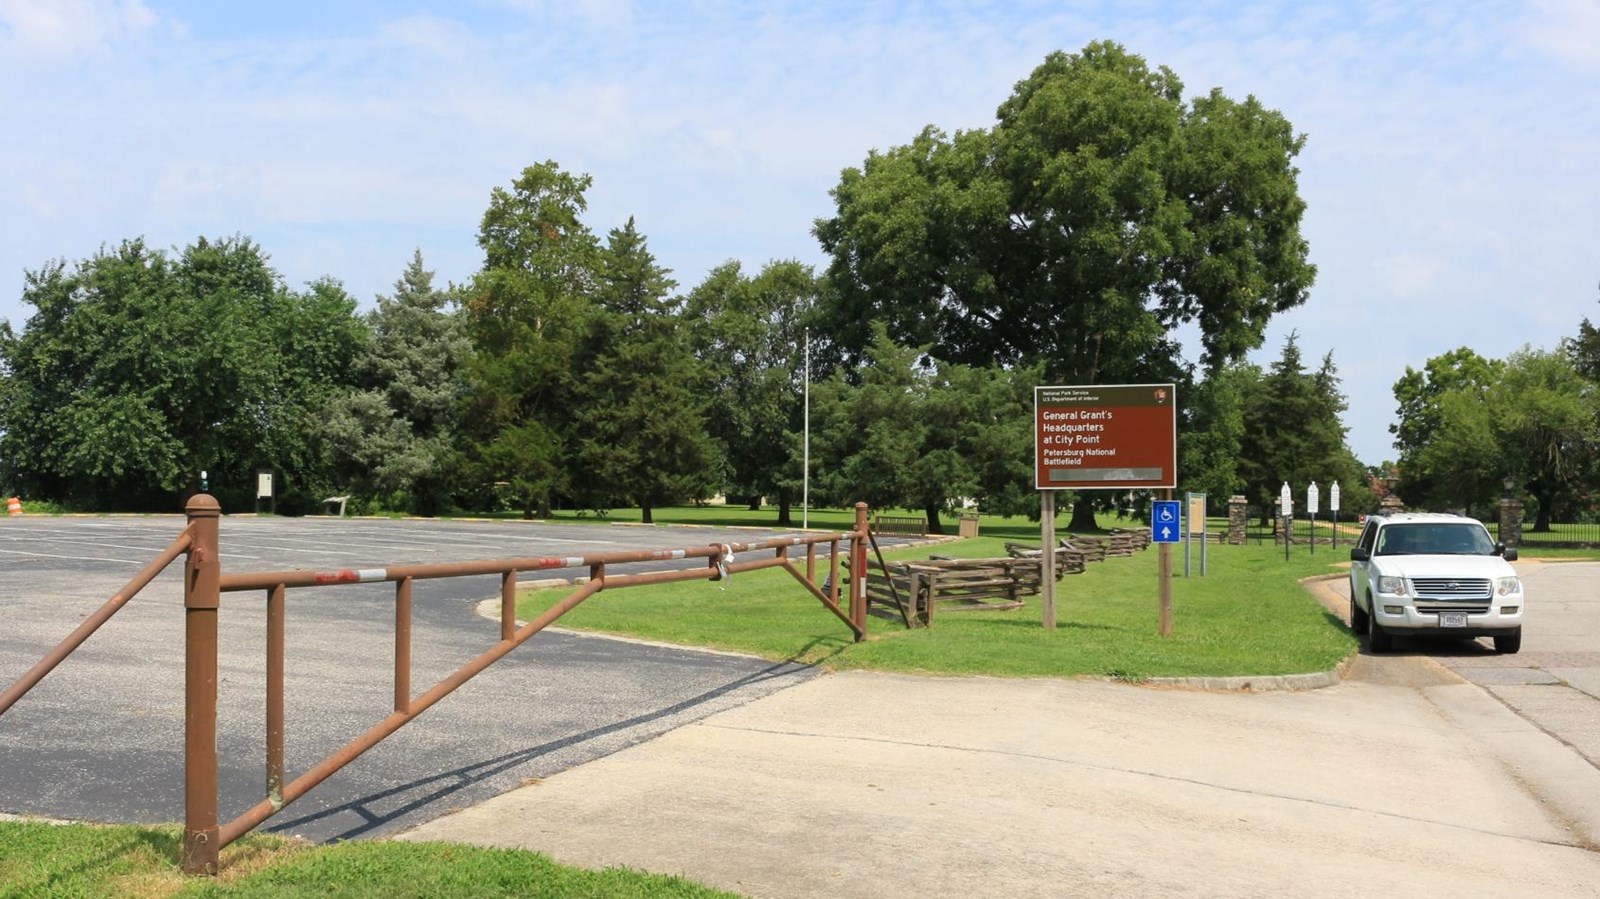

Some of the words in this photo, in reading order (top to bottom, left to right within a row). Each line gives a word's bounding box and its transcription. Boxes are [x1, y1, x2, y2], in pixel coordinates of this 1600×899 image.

[1043, 411, 1078, 420] General
[1080, 410, 1113, 420] Grant's
[1043, 423, 1104, 433] Headquarters
[1043, 435, 1053, 444] at
[1055, 435, 1073, 446] City
[1076, 434, 1100, 444] Point
[1043, 449, 1084, 457] Petersburg
[1085, 448, 1116, 456] National
[1043, 457, 1082, 465] Battlefield
